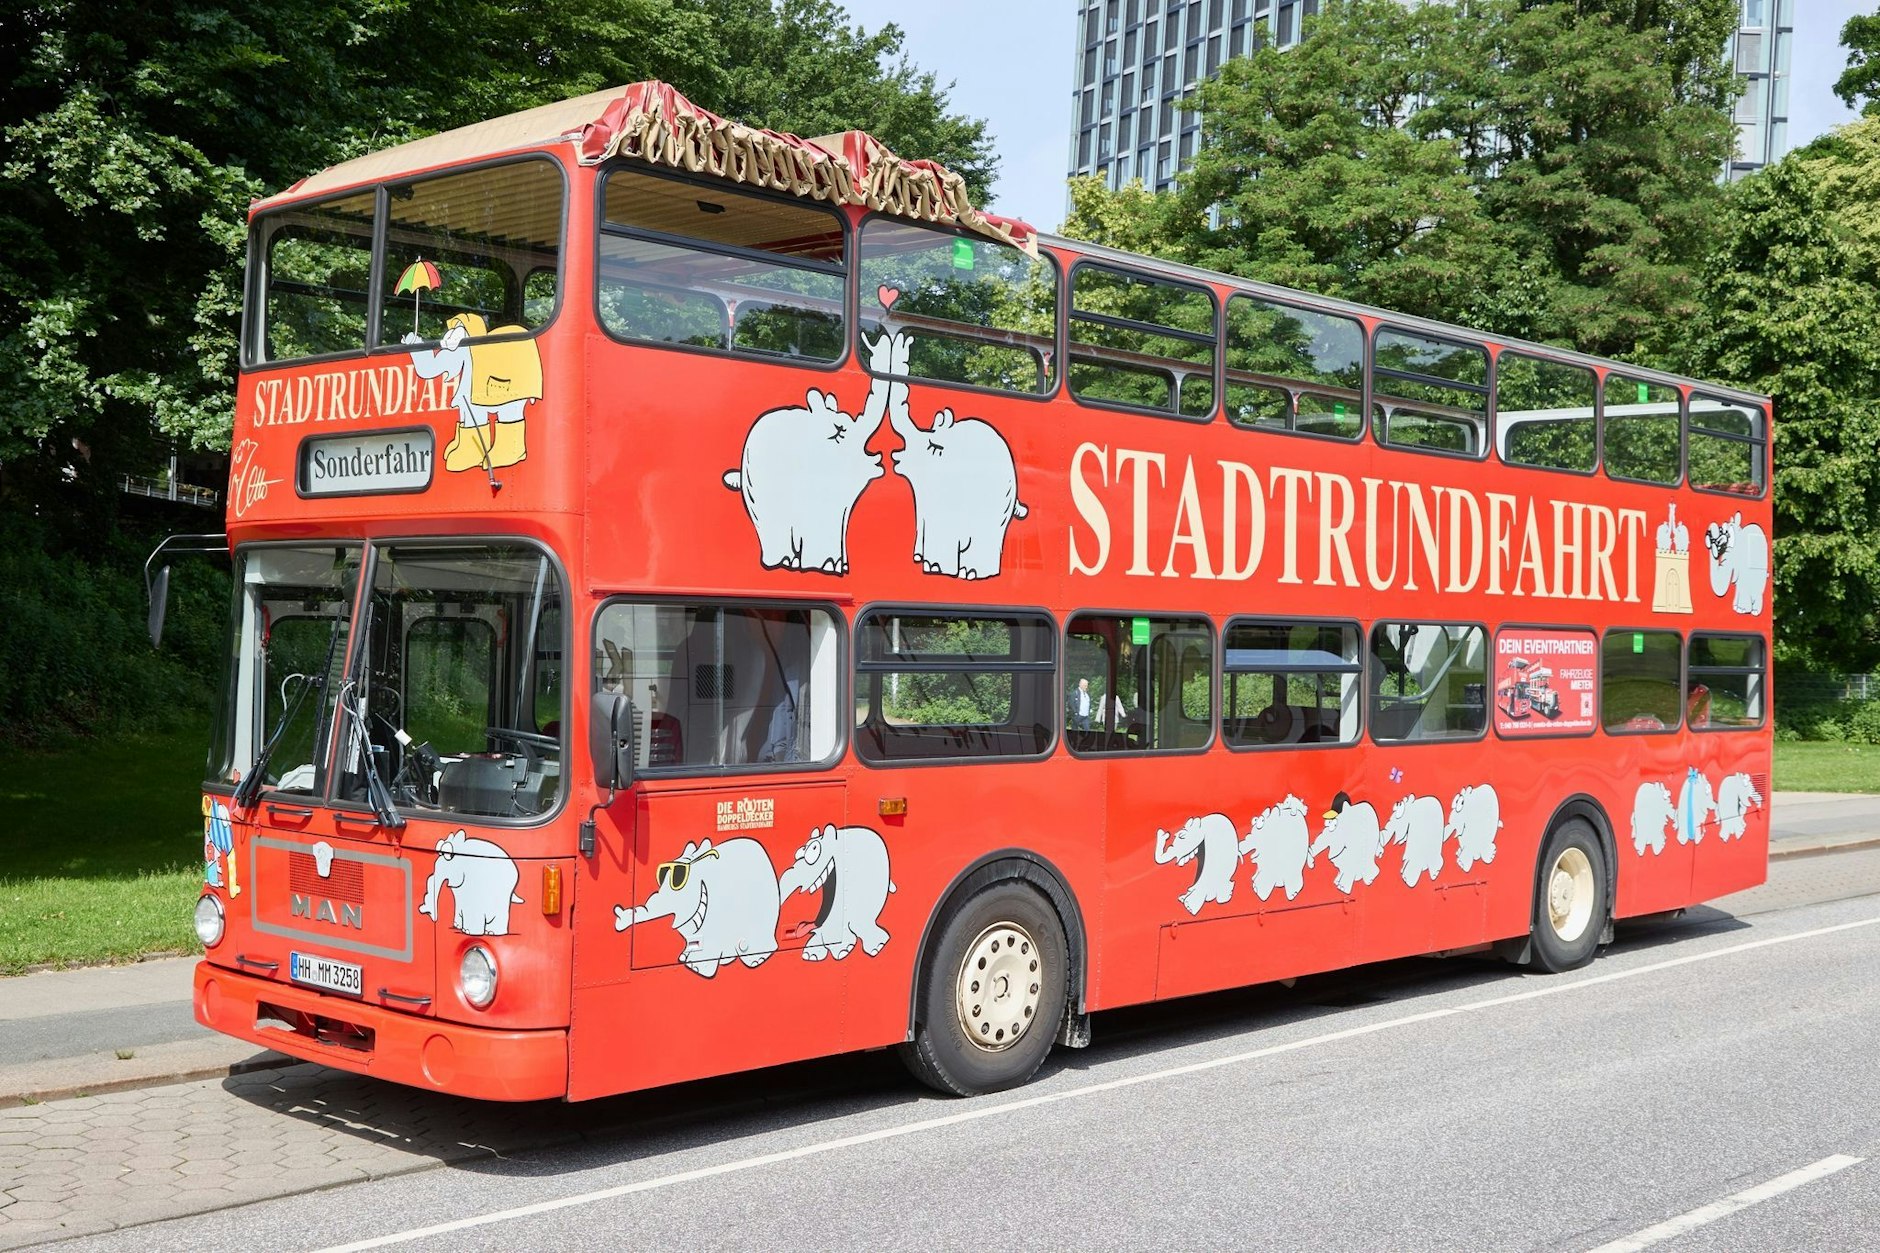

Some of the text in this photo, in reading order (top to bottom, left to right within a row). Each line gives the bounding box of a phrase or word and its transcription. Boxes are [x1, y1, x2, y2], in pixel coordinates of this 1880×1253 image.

[253, 364, 460, 429] STADTRUNDFAH
[314, 443, 432, 480] Sonderfahr
[1069, 442, 1647, 603] STADTRUNDFAHRT
[1499, 639, 1594, 655] DEIN EVENTPARTNER
[717, 802, 733, 815] DIE
[717, 812, 774, 825] DOPPELDECKER
[291, 894, 363, 931] MAN
[298, 957, 360, 990] HH MM 3258
